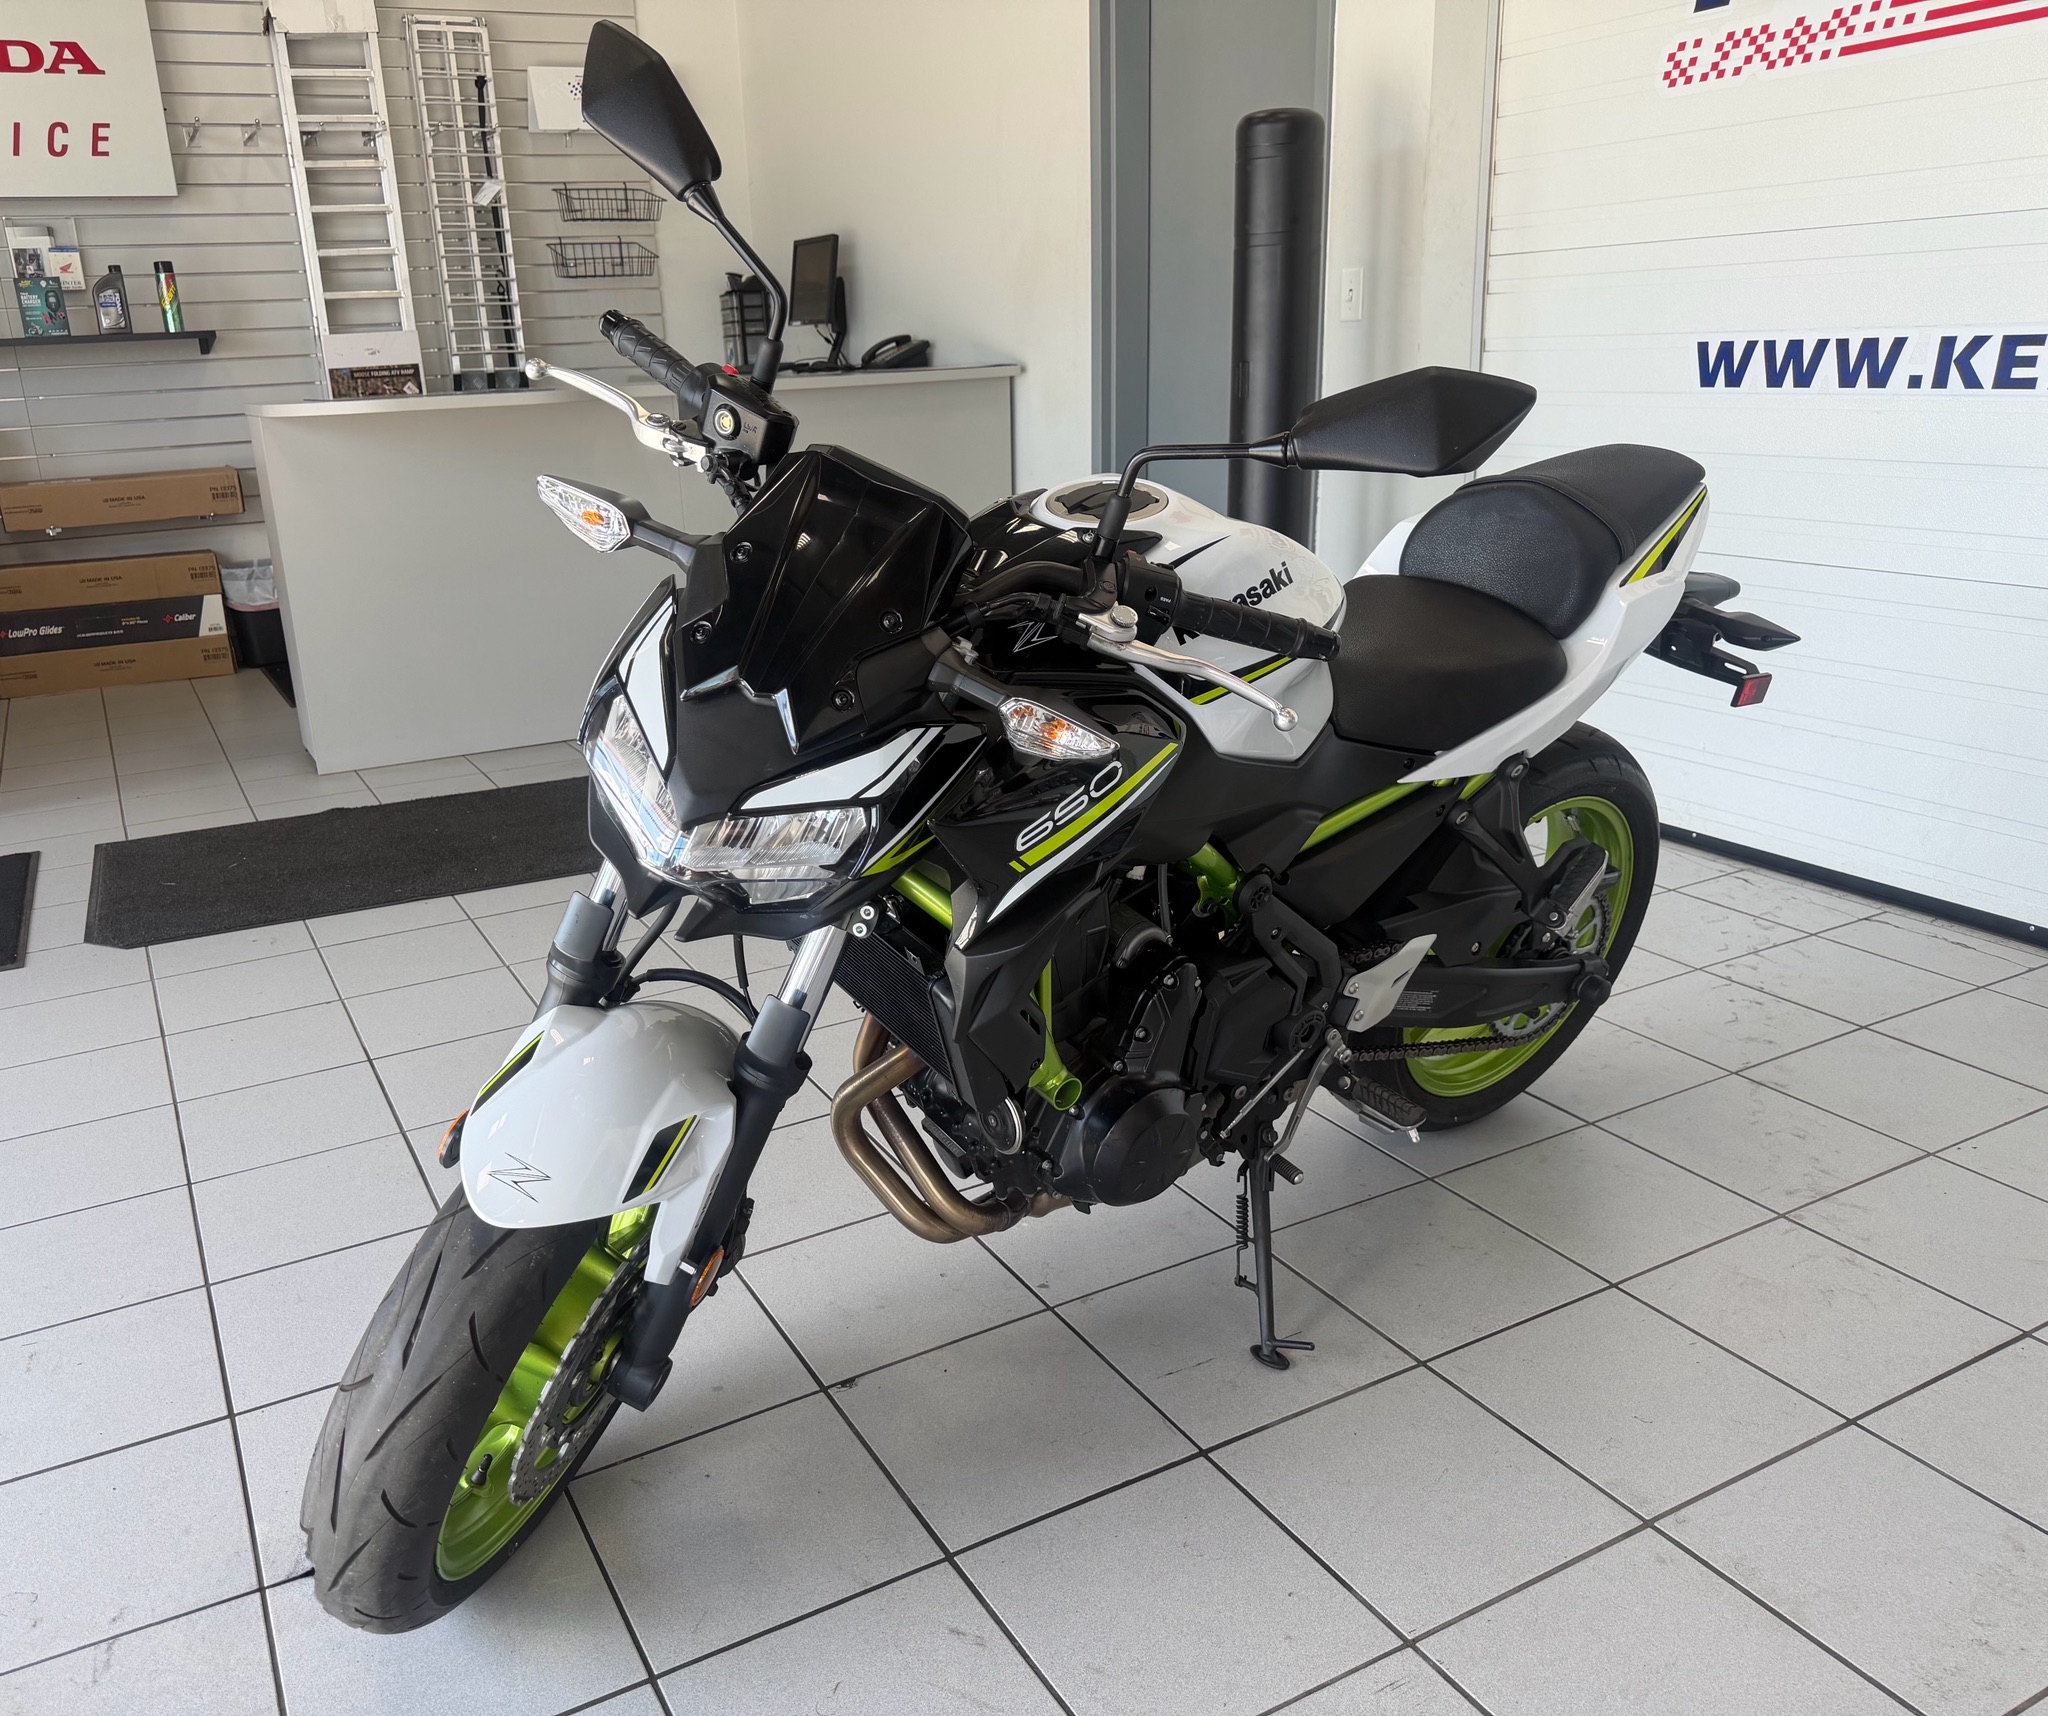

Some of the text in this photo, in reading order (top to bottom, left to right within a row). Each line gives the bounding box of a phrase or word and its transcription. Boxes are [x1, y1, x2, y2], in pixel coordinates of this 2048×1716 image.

[0, 40, 106, 75] DA
[12, 121, 111, 157] ICE
[8, 624, 63, 639] LowPro Glides
[174, 613, 197, 622] Caliber
[1016, 761, 1123, 852] 650
